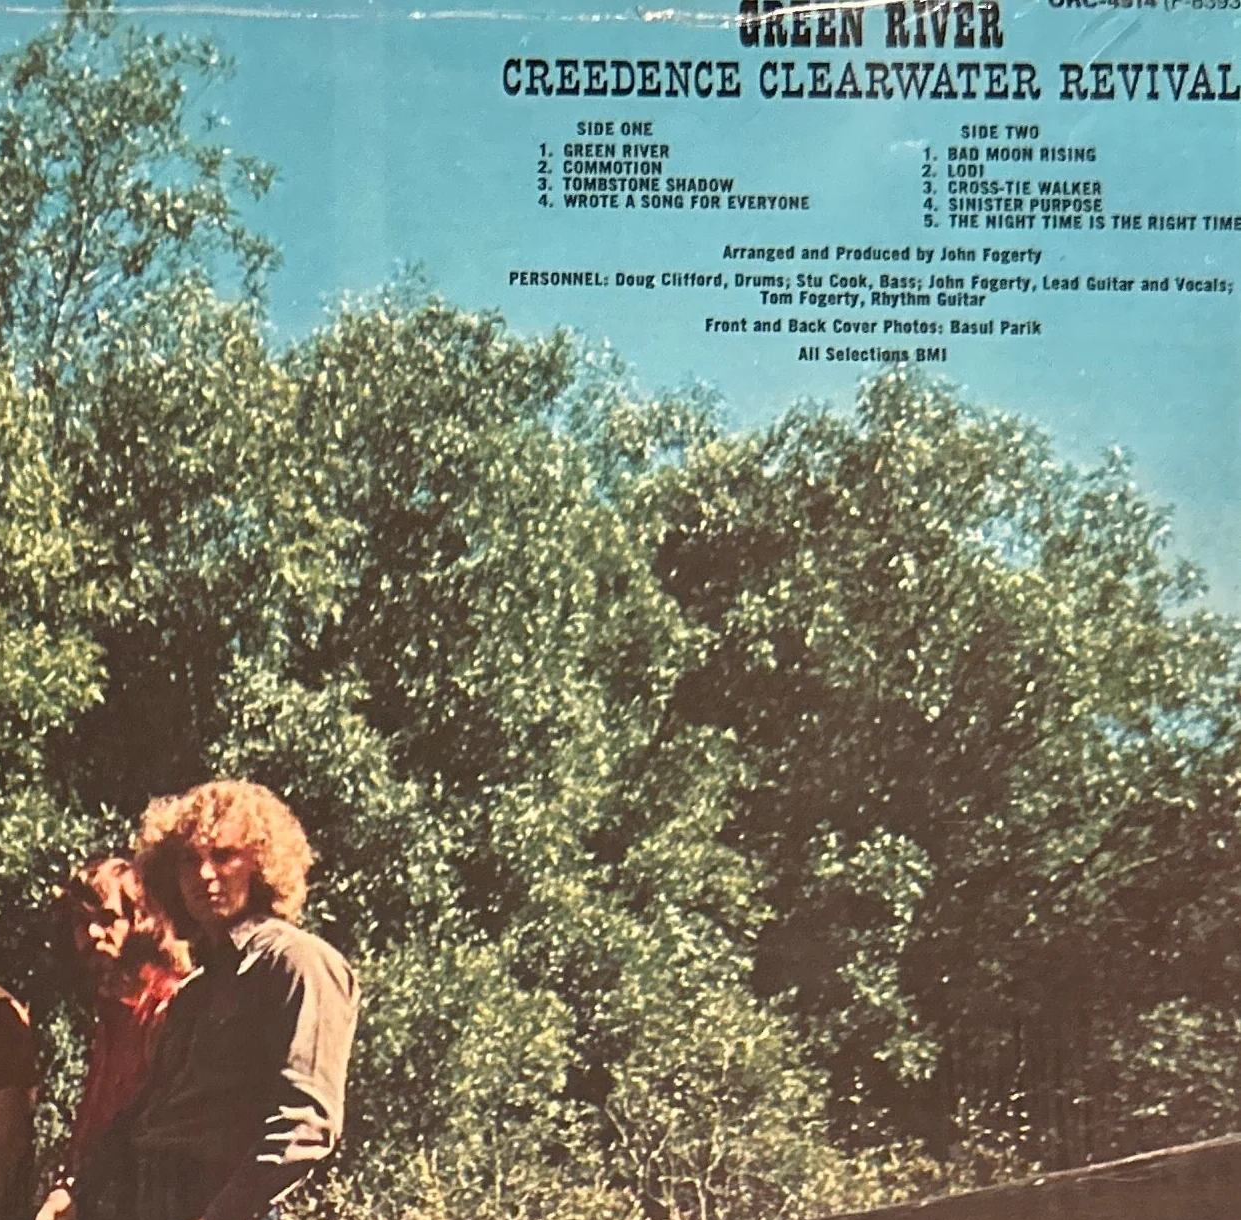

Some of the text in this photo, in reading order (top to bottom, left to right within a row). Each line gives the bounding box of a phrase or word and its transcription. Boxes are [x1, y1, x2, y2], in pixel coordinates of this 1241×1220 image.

[739, 0, 1004, 49] GREEN RIVER
[503, 58, 1241, 102] CREEDENCE CLEARWATER REVIVAL
[577, 121, 653, 136] SIDE ONE
[960, 124, 1039, 139] SIDE TWO
[539, 143, 670, 158] 1. GREEN RIVER
[923, 147, 1097, 162] 1. BAD MOON RISING
[537, 160, 662, 175] 2. COMMOTION
[922, 164, 984, 178] 2. LODI
[537, 177, 734, 193] 3. TOMBSTONE SHADOW
[923, 181, 1102, 196] 3. CROSS-TIE WALKER
[538, 194, 810, 211] 4. WROTE A SONG FOR EVERYONE
[923, 197, 1103, 213] 4. SINISTER PURPOSE
[924, 213, 1241, 231] 5. THE NIGHT TIME IS THE RIGHT TIME
[723, 244, 1043, 265] Arranged and Produced by John Fogerty
[509, 271, 1234, 295] PERSONNEL: Doug Clifford, Drums; Stu Cook, Bass; John Fogerty, Lead Guitar and Vocals;
[760, 291, 986, 309] Tom Fogerty, Rhythm Guitar
[705, 318, 1043, 336] Front and Back Cover Photos: Basul Parik
[798, 347, 947, 362] All Selections BMI
